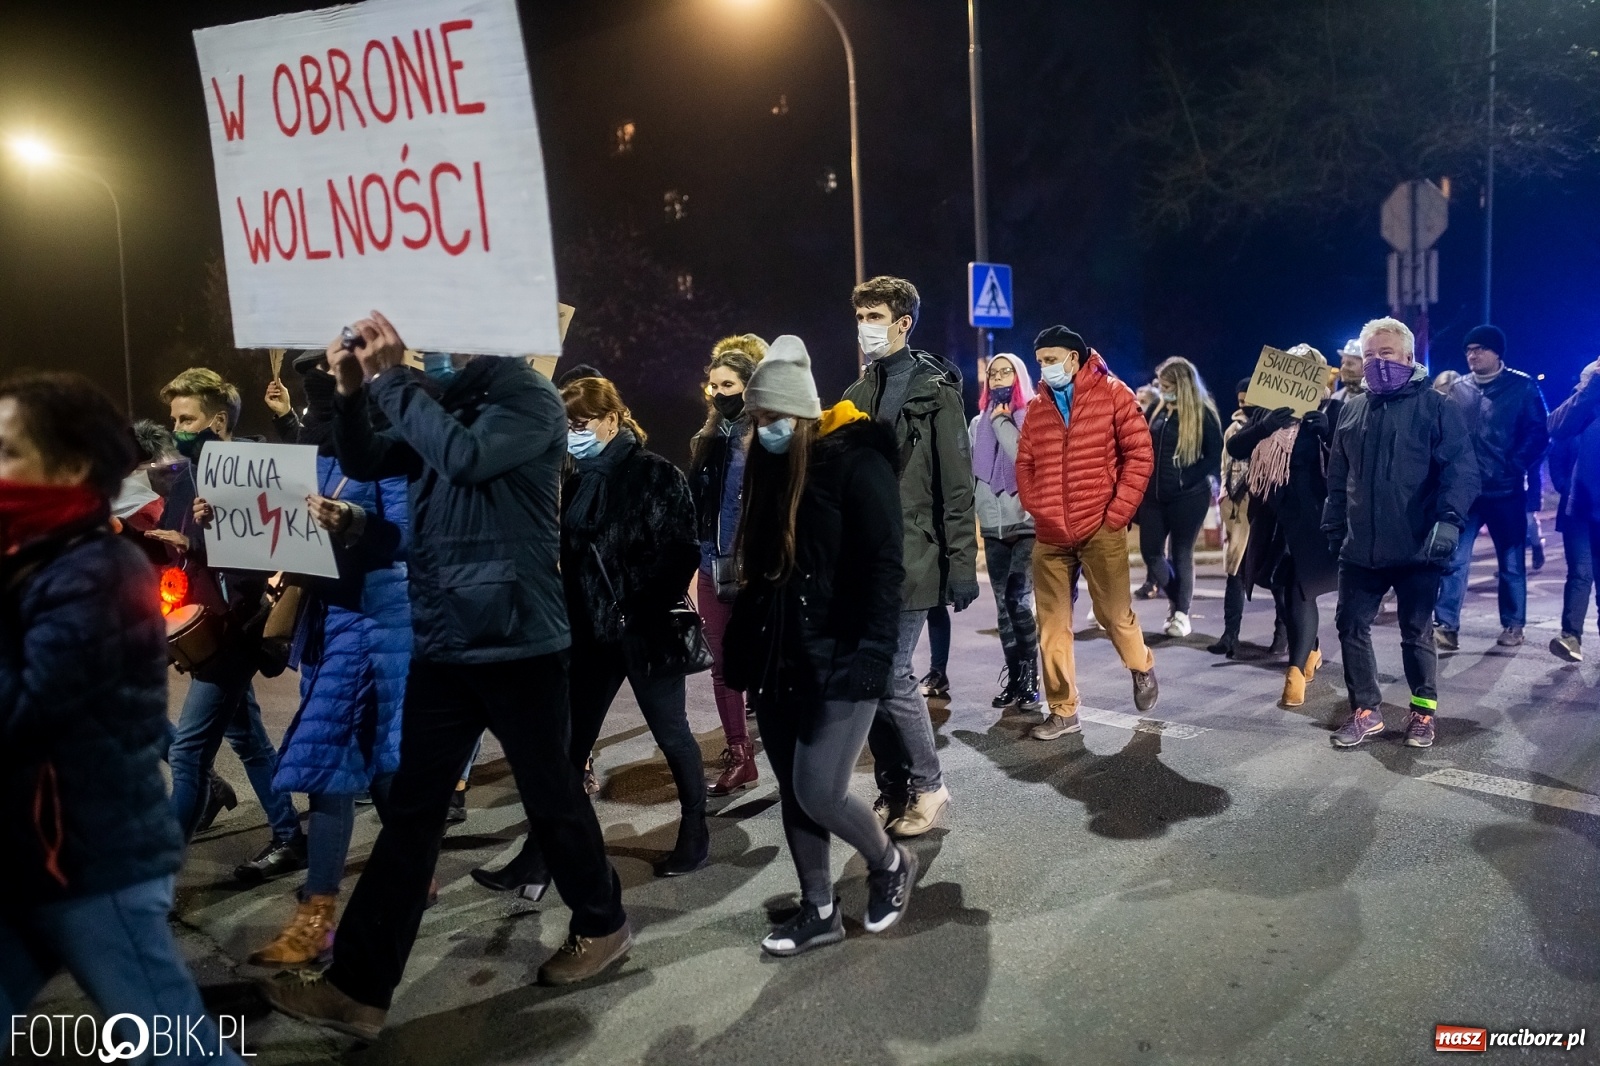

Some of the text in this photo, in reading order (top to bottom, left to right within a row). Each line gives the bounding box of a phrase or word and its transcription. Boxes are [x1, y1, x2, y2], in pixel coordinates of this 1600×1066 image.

[211, 19, 486, 141] W OBRONIE
[237, 143, 490, 265] WOLNOŚCI
[1256, 371, 1318, 403] PAŃSTWO
[1263, 351, 1326, 385] ŚWIECKIE
[204, 452, 282, 490] WOLNA
